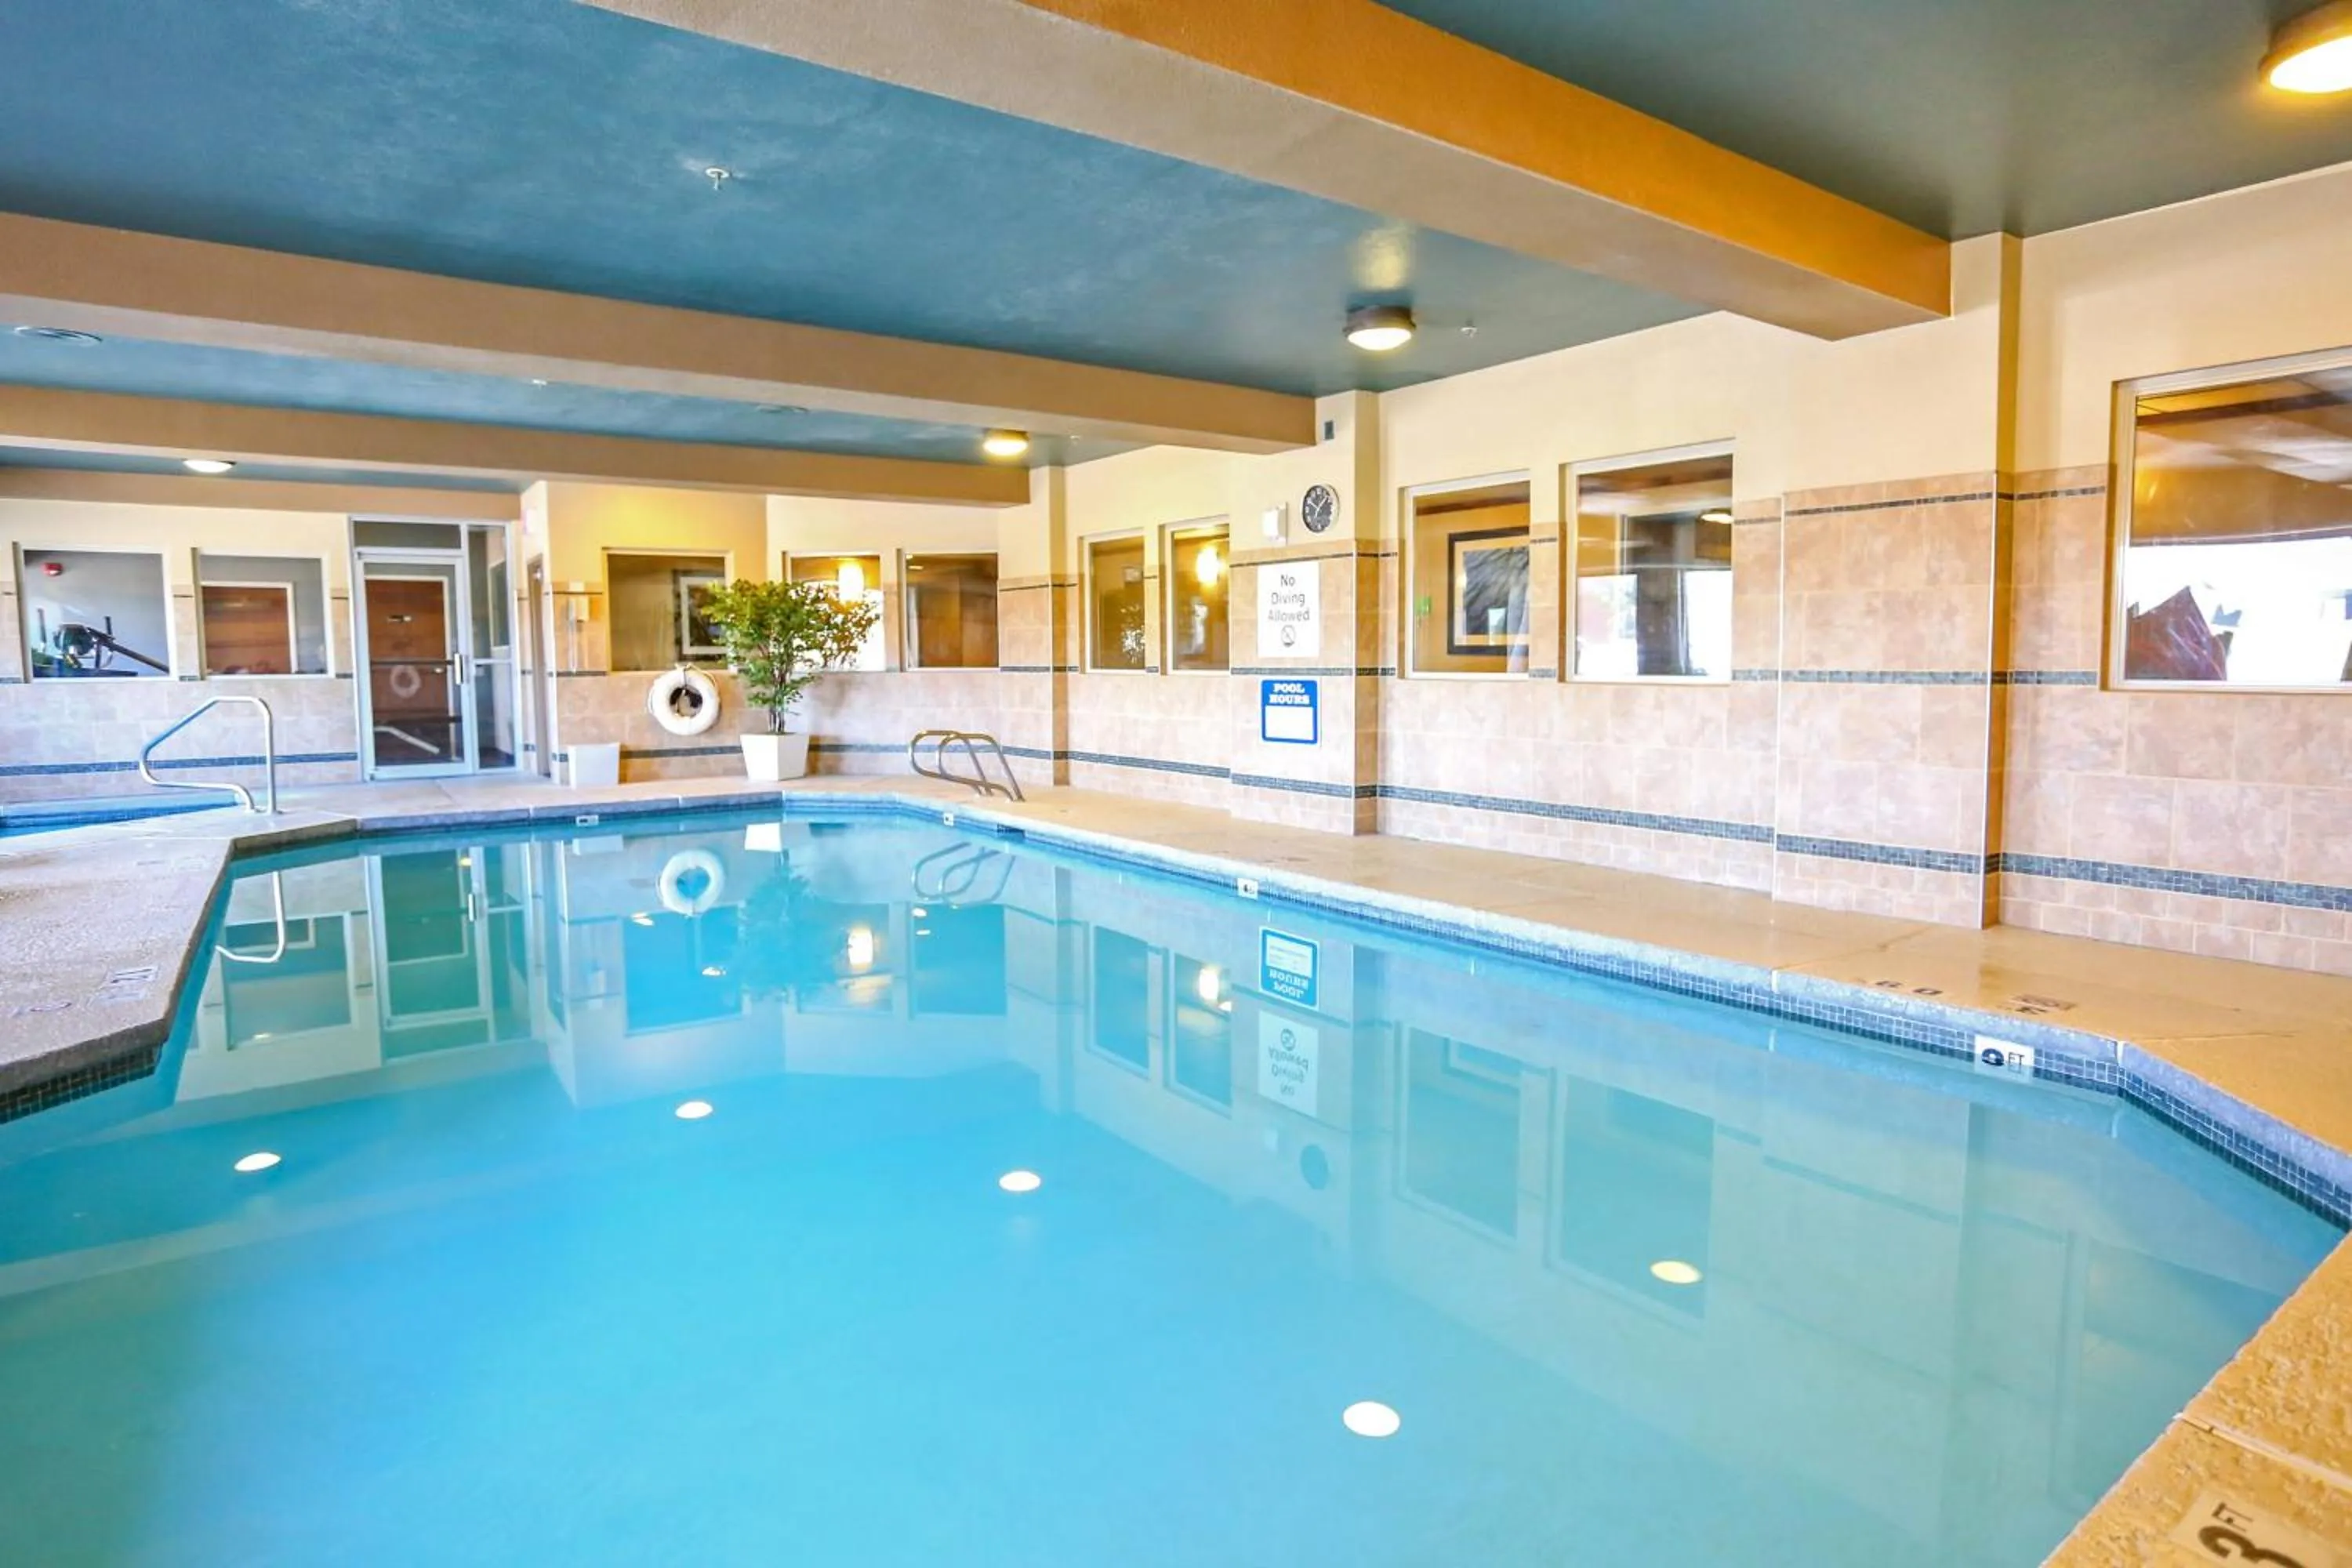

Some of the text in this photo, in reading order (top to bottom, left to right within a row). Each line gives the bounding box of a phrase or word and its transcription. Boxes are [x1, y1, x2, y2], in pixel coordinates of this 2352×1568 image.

[1279, 574, 1295, 587] No
[1271, 591, 1305, 608] Diving
[1268, 608, 1310, 622] Allowed
[1272, 682, 1305, 694] POOL
[1269, 694, 1310, 705] HOURS
